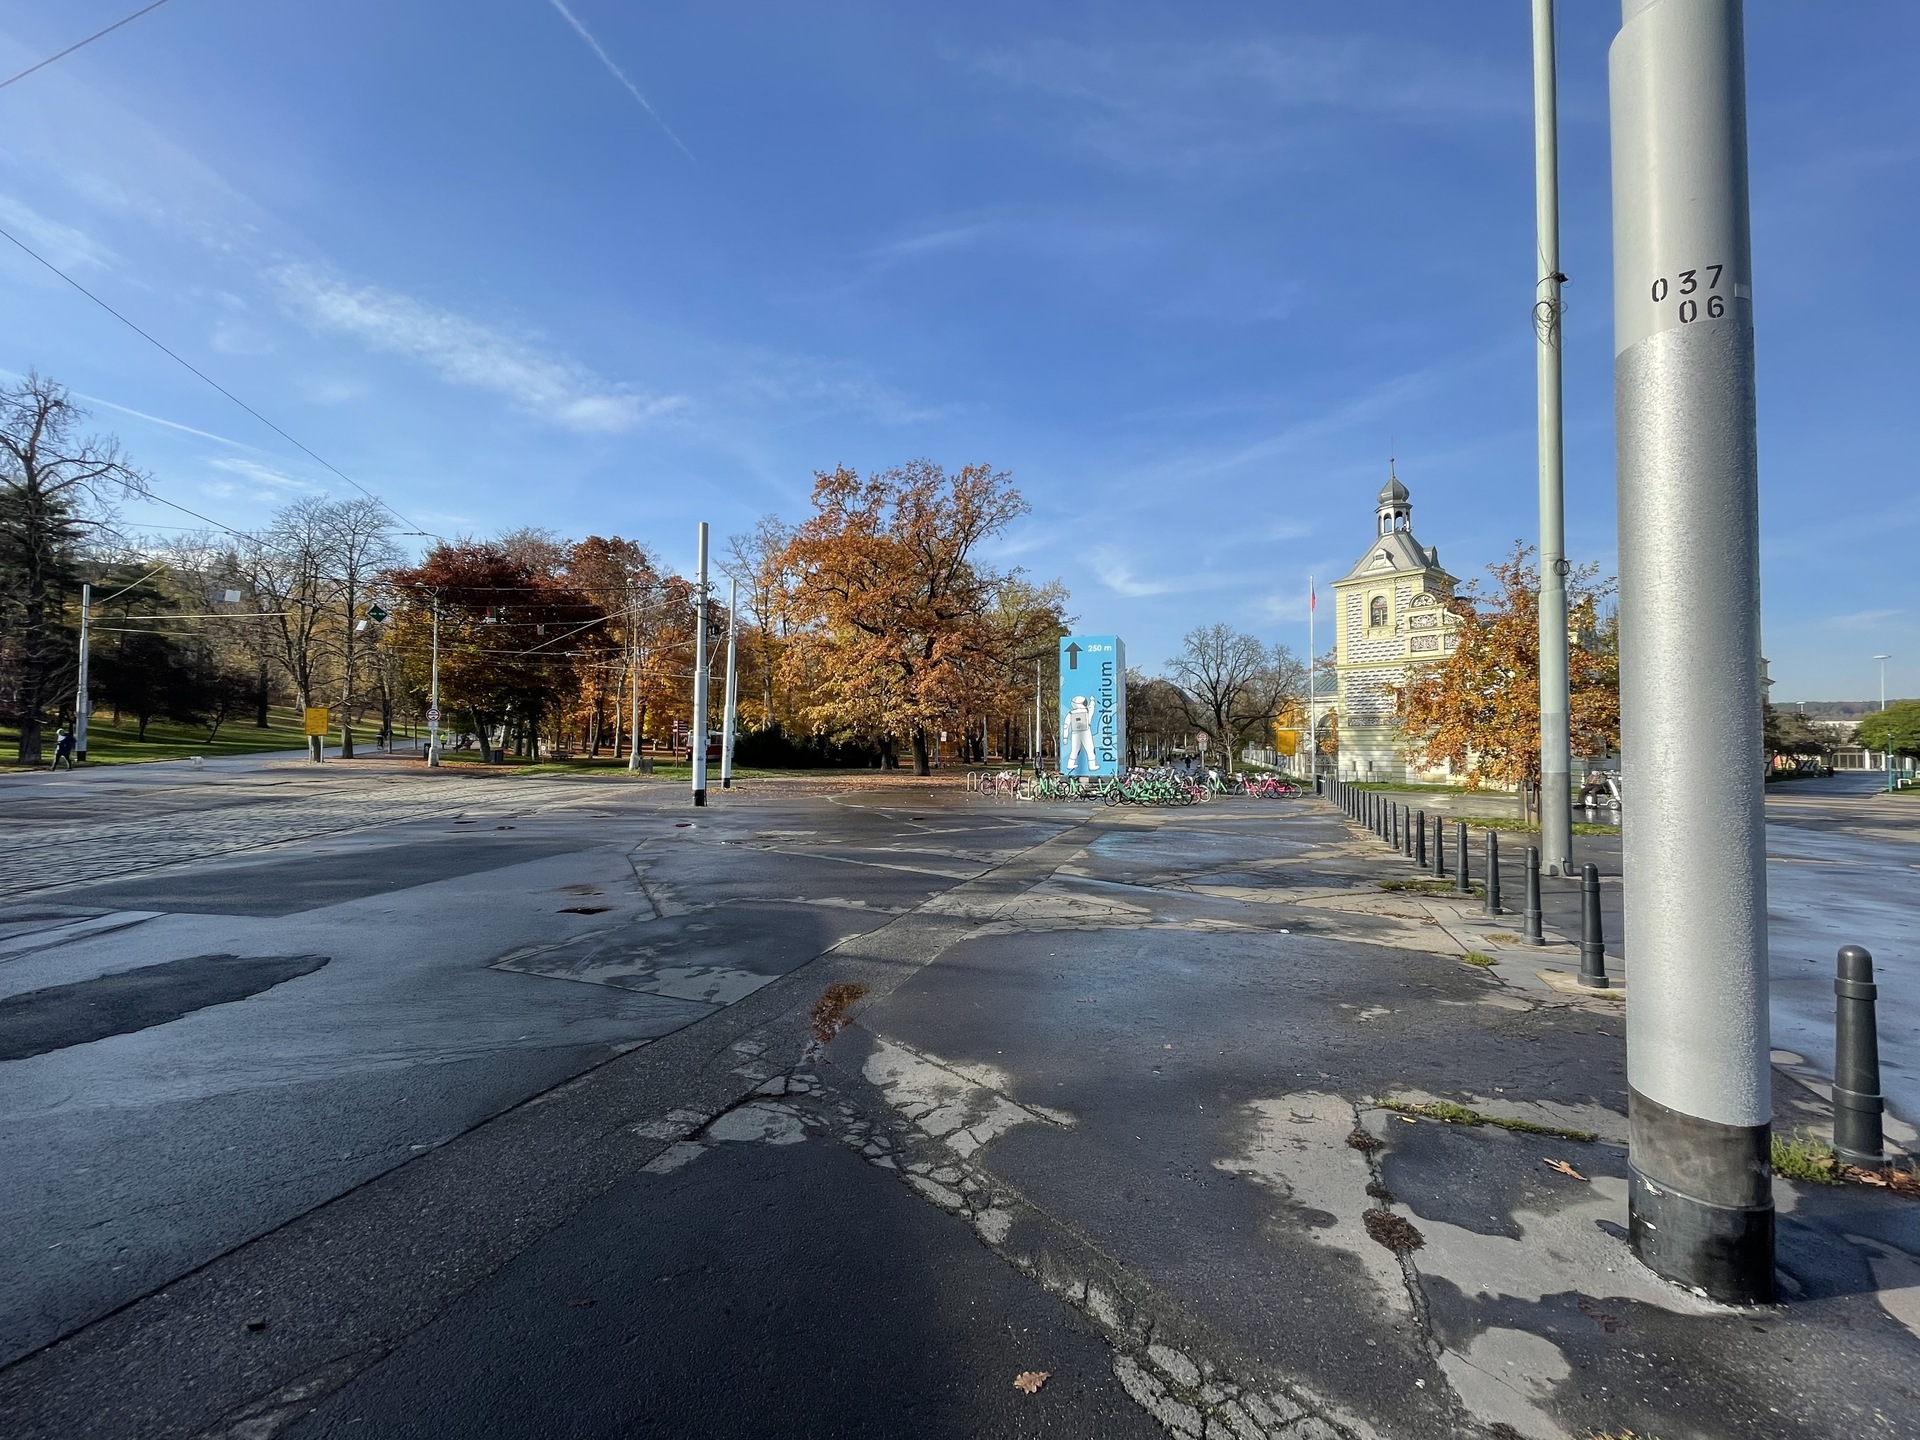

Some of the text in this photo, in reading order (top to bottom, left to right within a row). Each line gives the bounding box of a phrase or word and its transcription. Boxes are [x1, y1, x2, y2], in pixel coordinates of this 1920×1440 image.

[1679, 295, 1724, 324] 06
[1088, 644, 1103, 652] 250
[1097, 661, 1116, 762] planetárium
